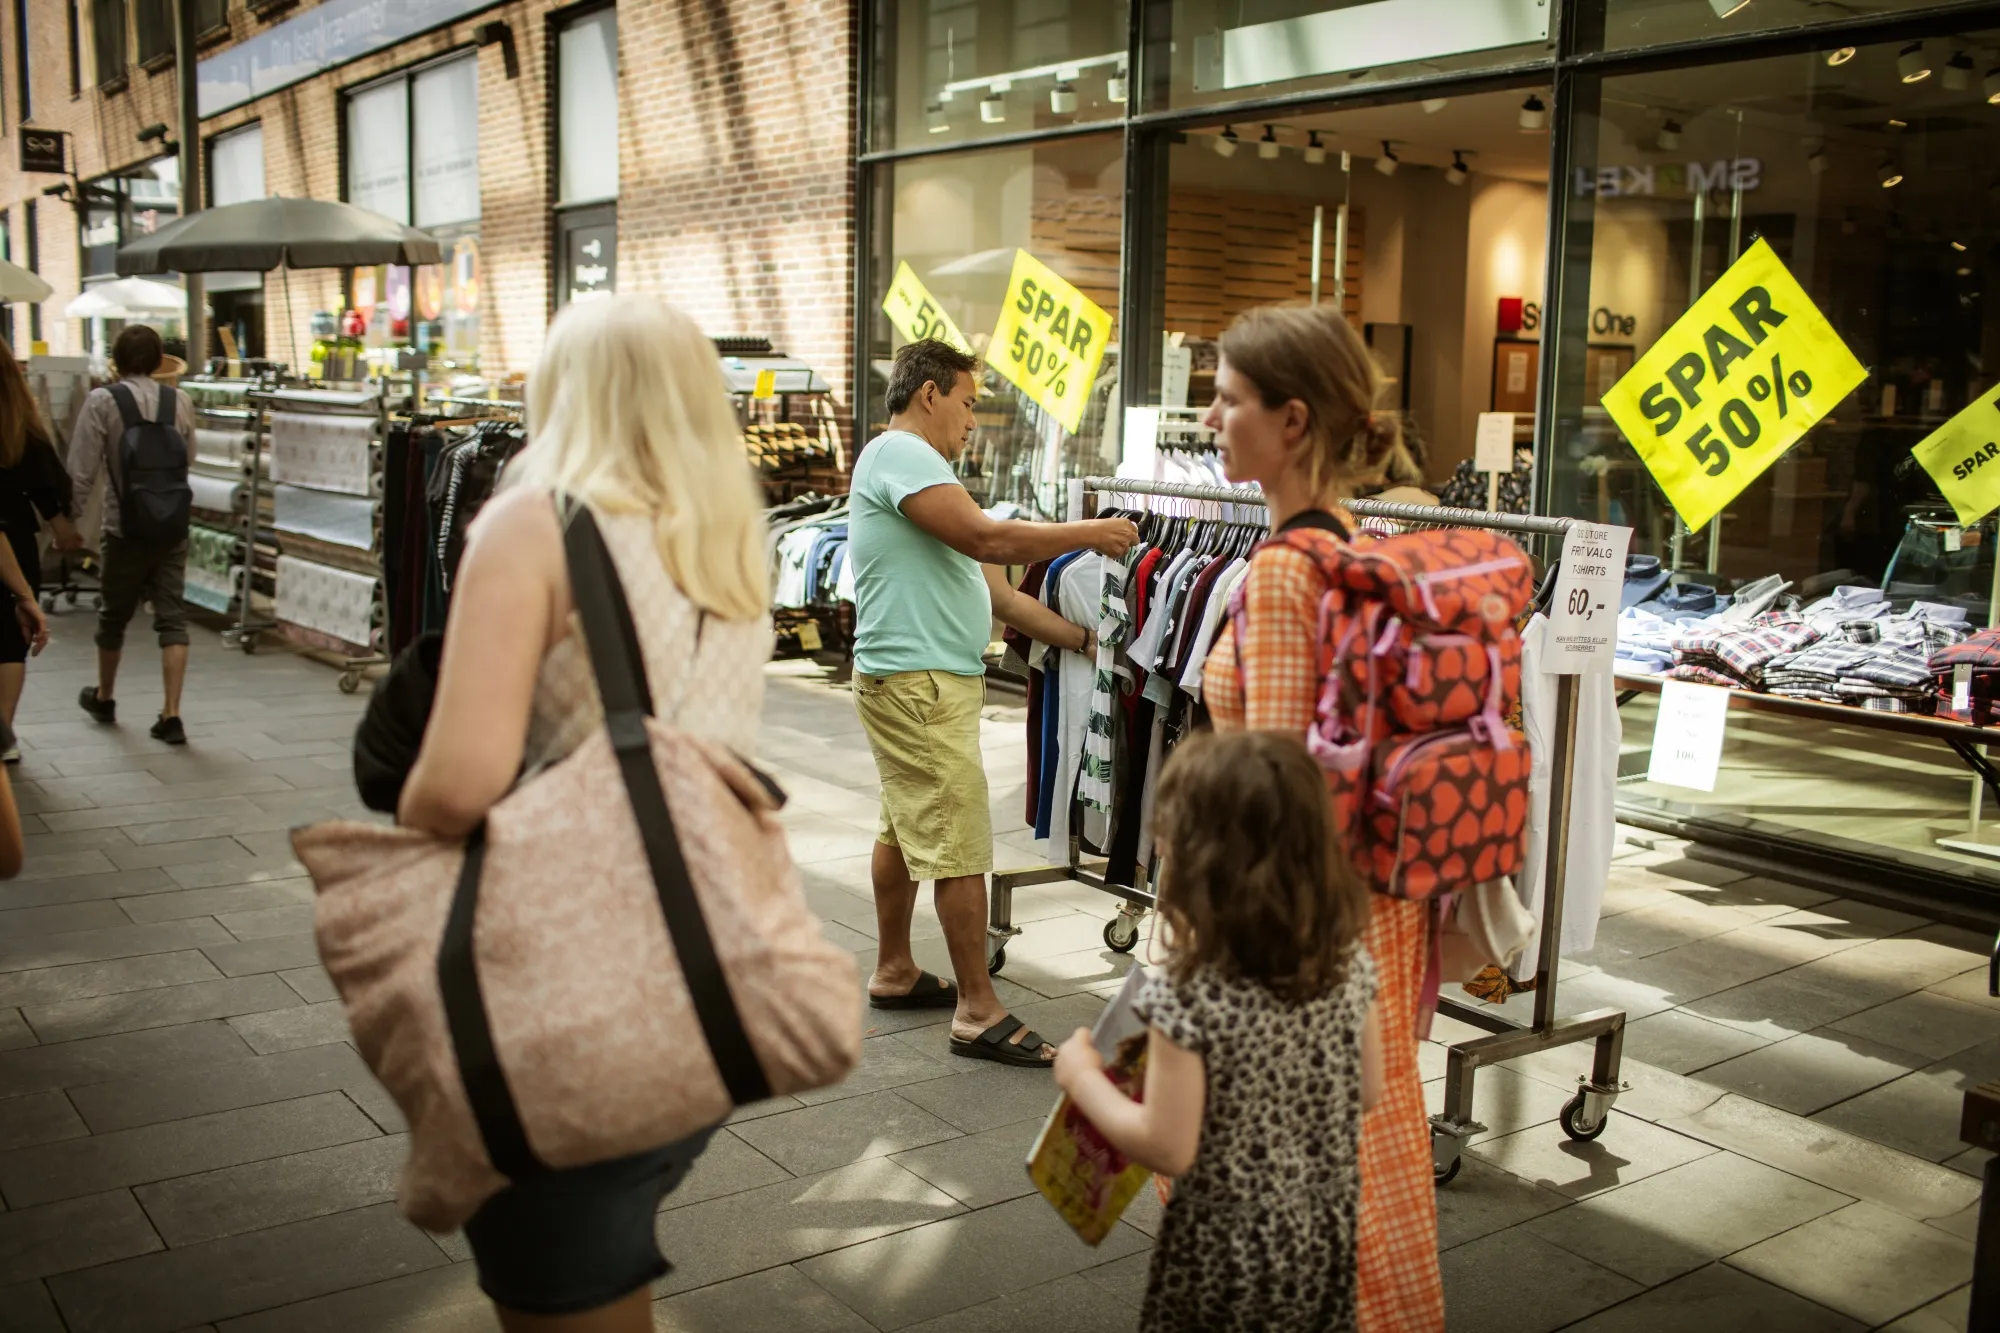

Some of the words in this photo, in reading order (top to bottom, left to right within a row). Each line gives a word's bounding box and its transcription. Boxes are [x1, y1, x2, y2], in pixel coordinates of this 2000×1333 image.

[912, 299, 952, 343] 50
[1016, 278, 1093, 361] SPAR
[1593, 306, 1636, 336] One
[1011, 327, 1068, 398] 50%
[1639, 285, 1789, 437] SPAR
[1684, 352, 1813, 477] 50%
[1952, 441, 2000, 481] SPAR
[1570, 545, 1585, 557] FRIT
[1586, 546, 1613, 559] VALG
[1585, 530, 1608, 540] STORE
[1572, 564, 1607, 576] T-SHIRTS
[1568, 588, 1605, 621] 60,-
